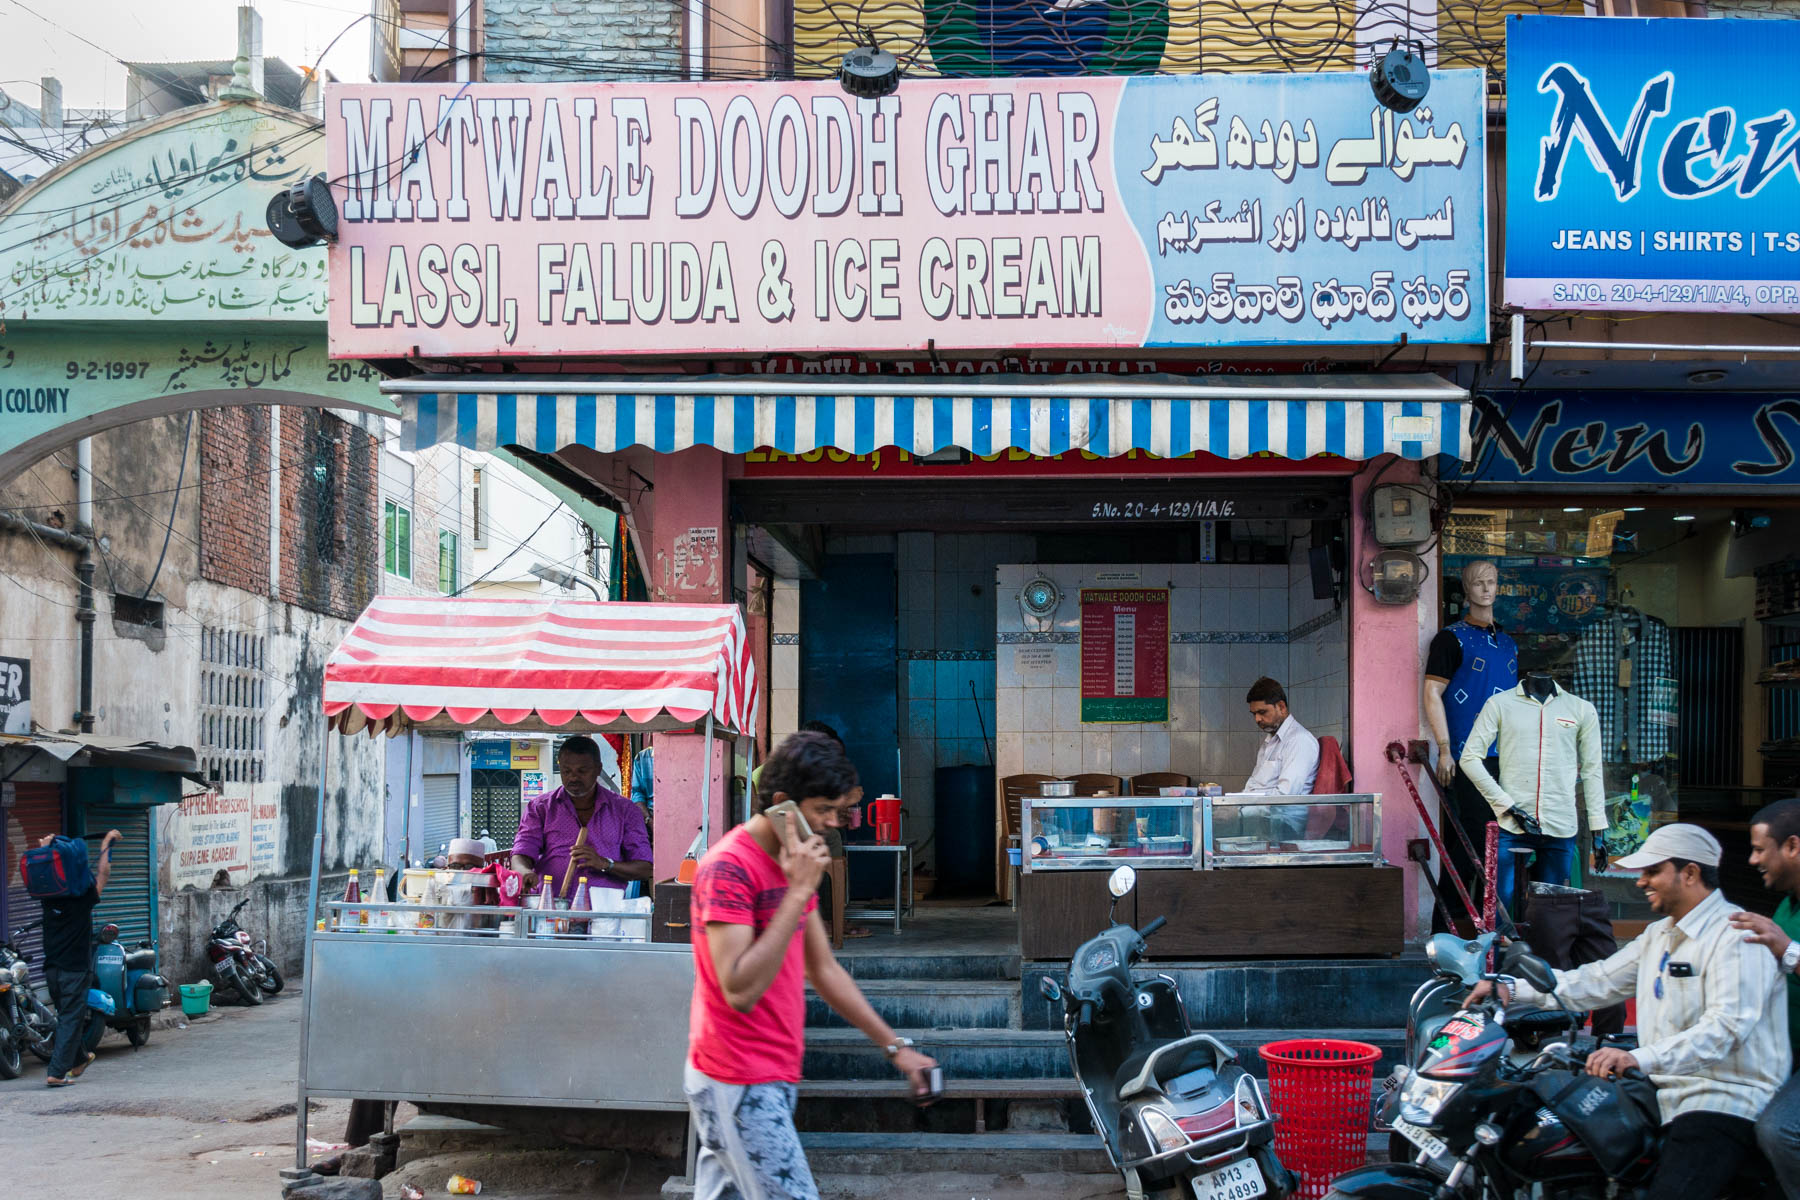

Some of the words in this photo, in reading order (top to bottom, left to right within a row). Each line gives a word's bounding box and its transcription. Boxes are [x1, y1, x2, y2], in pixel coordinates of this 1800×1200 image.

[341, 95, 654, 222] MATWALE
[675, 94, 902, 221] DOODH
[925, 92, 1104, 217] GHAR
[1396, 196, 1454, 250] لسی
[1552, 231, 1632, 250] JEANS
[1653, 232, 1743, 252] SHIRTS
[350, 243, 518, 346] LASSI,
[537, 241, 740, 326] FALUDA
[757, 239, 795, 323] &
[814, 237, 901, 322] ICE
[918, 236, 1103, 320] CREAM
[1553, 284, 1606, 302] S.NO.
[1756, 286, 1798, 303] OPP.
[66, 361, 150, 380] 9-2-1997
[6, 388, 70, 414] COLONY
[1461, 395, 1705, 475] New
[1113, 605, 1137, 613] Menu
[1212, 1166, 1243, 1189] AP13
